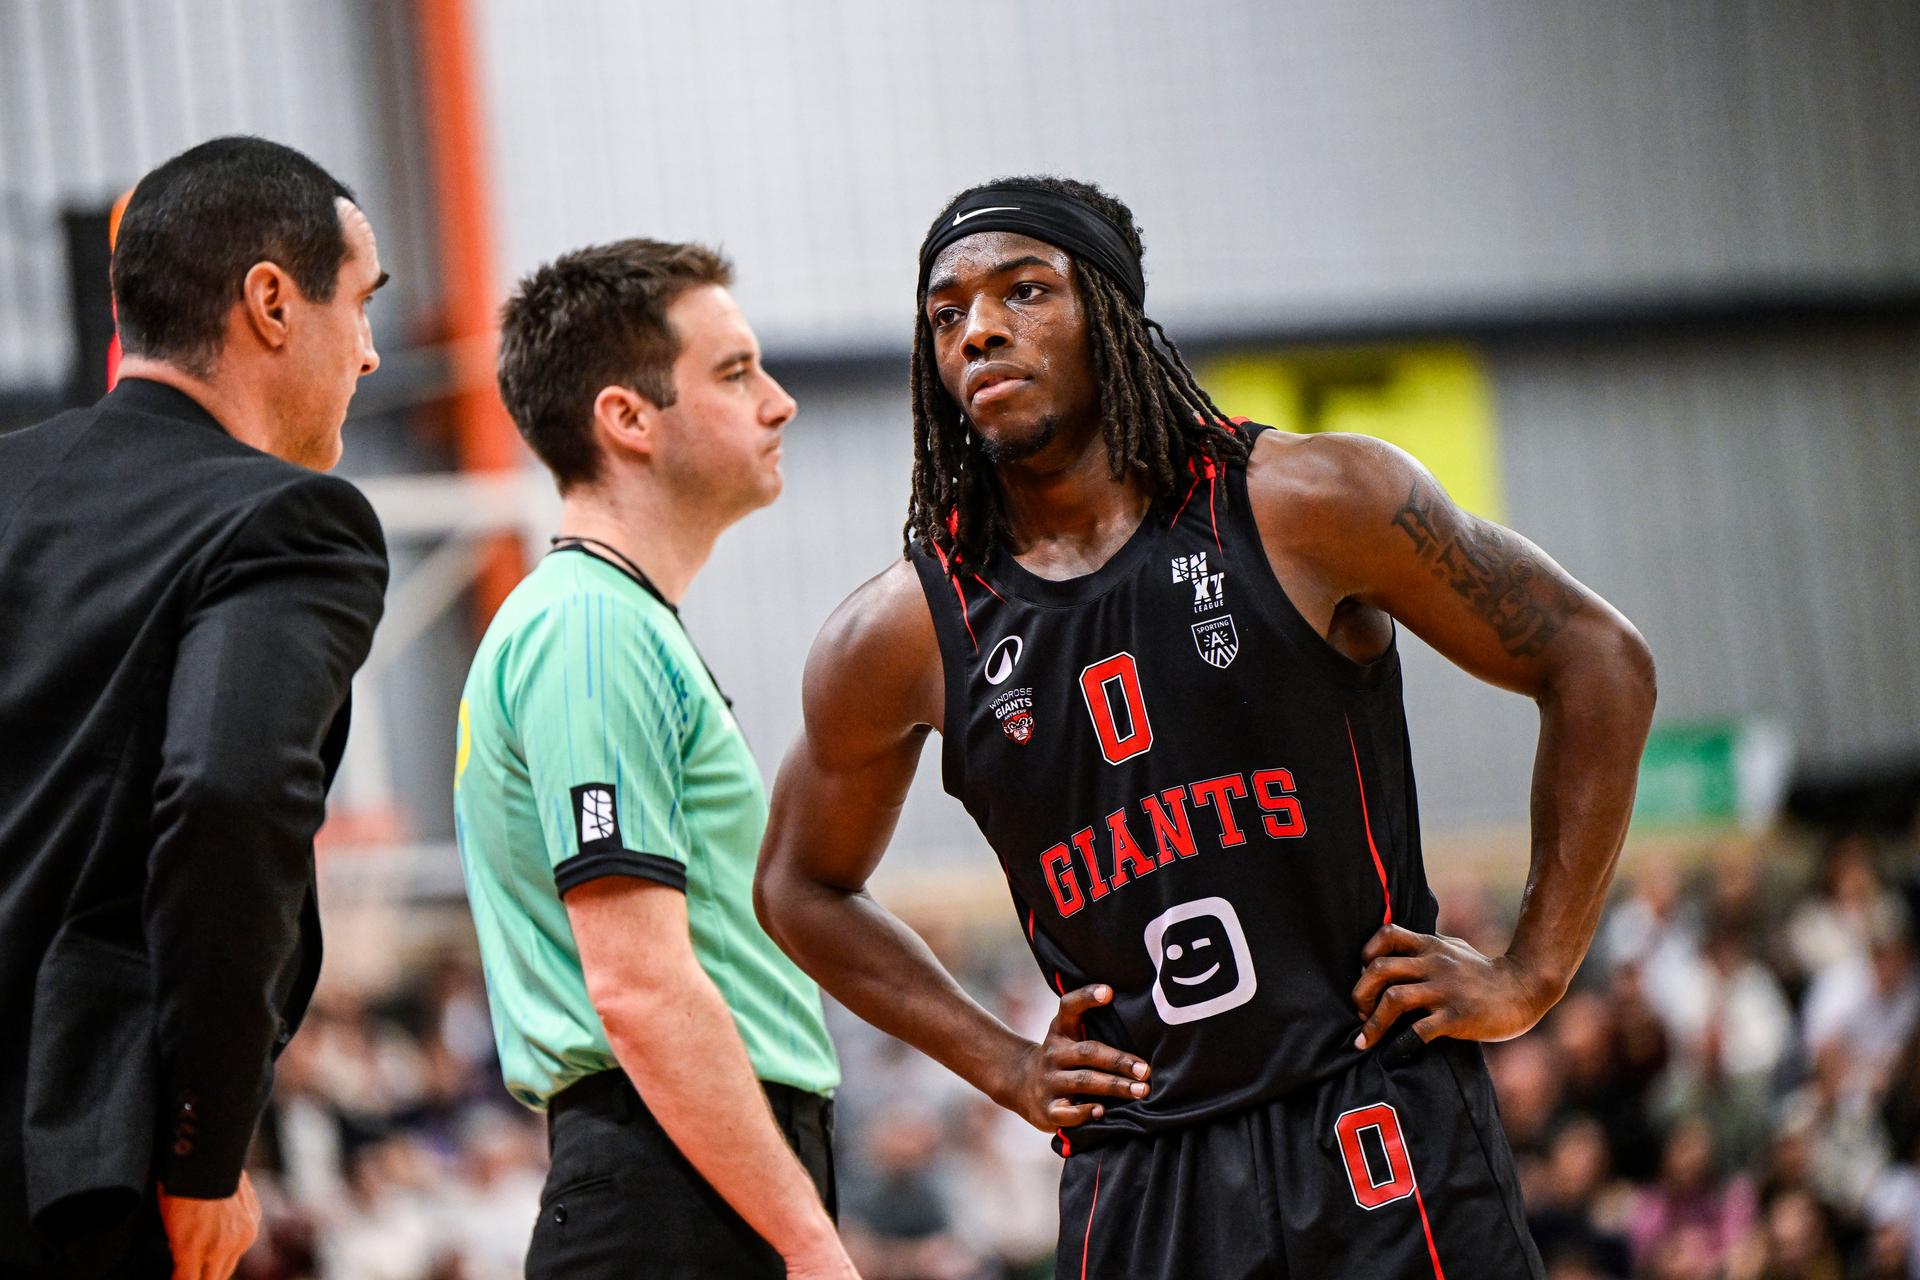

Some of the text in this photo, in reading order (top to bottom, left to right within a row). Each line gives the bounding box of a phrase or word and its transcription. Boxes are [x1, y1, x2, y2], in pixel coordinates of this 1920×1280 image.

[1194, 599, 1225, 614] LEAGUE
[1196, 619, 1230, 634] SPORTING
[989, 687, 1033, 710] WINDROSE
[995, 698, 1033, 719] GIANTS
[1079, 651, 1153, 765] 0
[1039, 767, 1308, 918] GIANTS
[1334, 1102, 1417, 1210] 0
